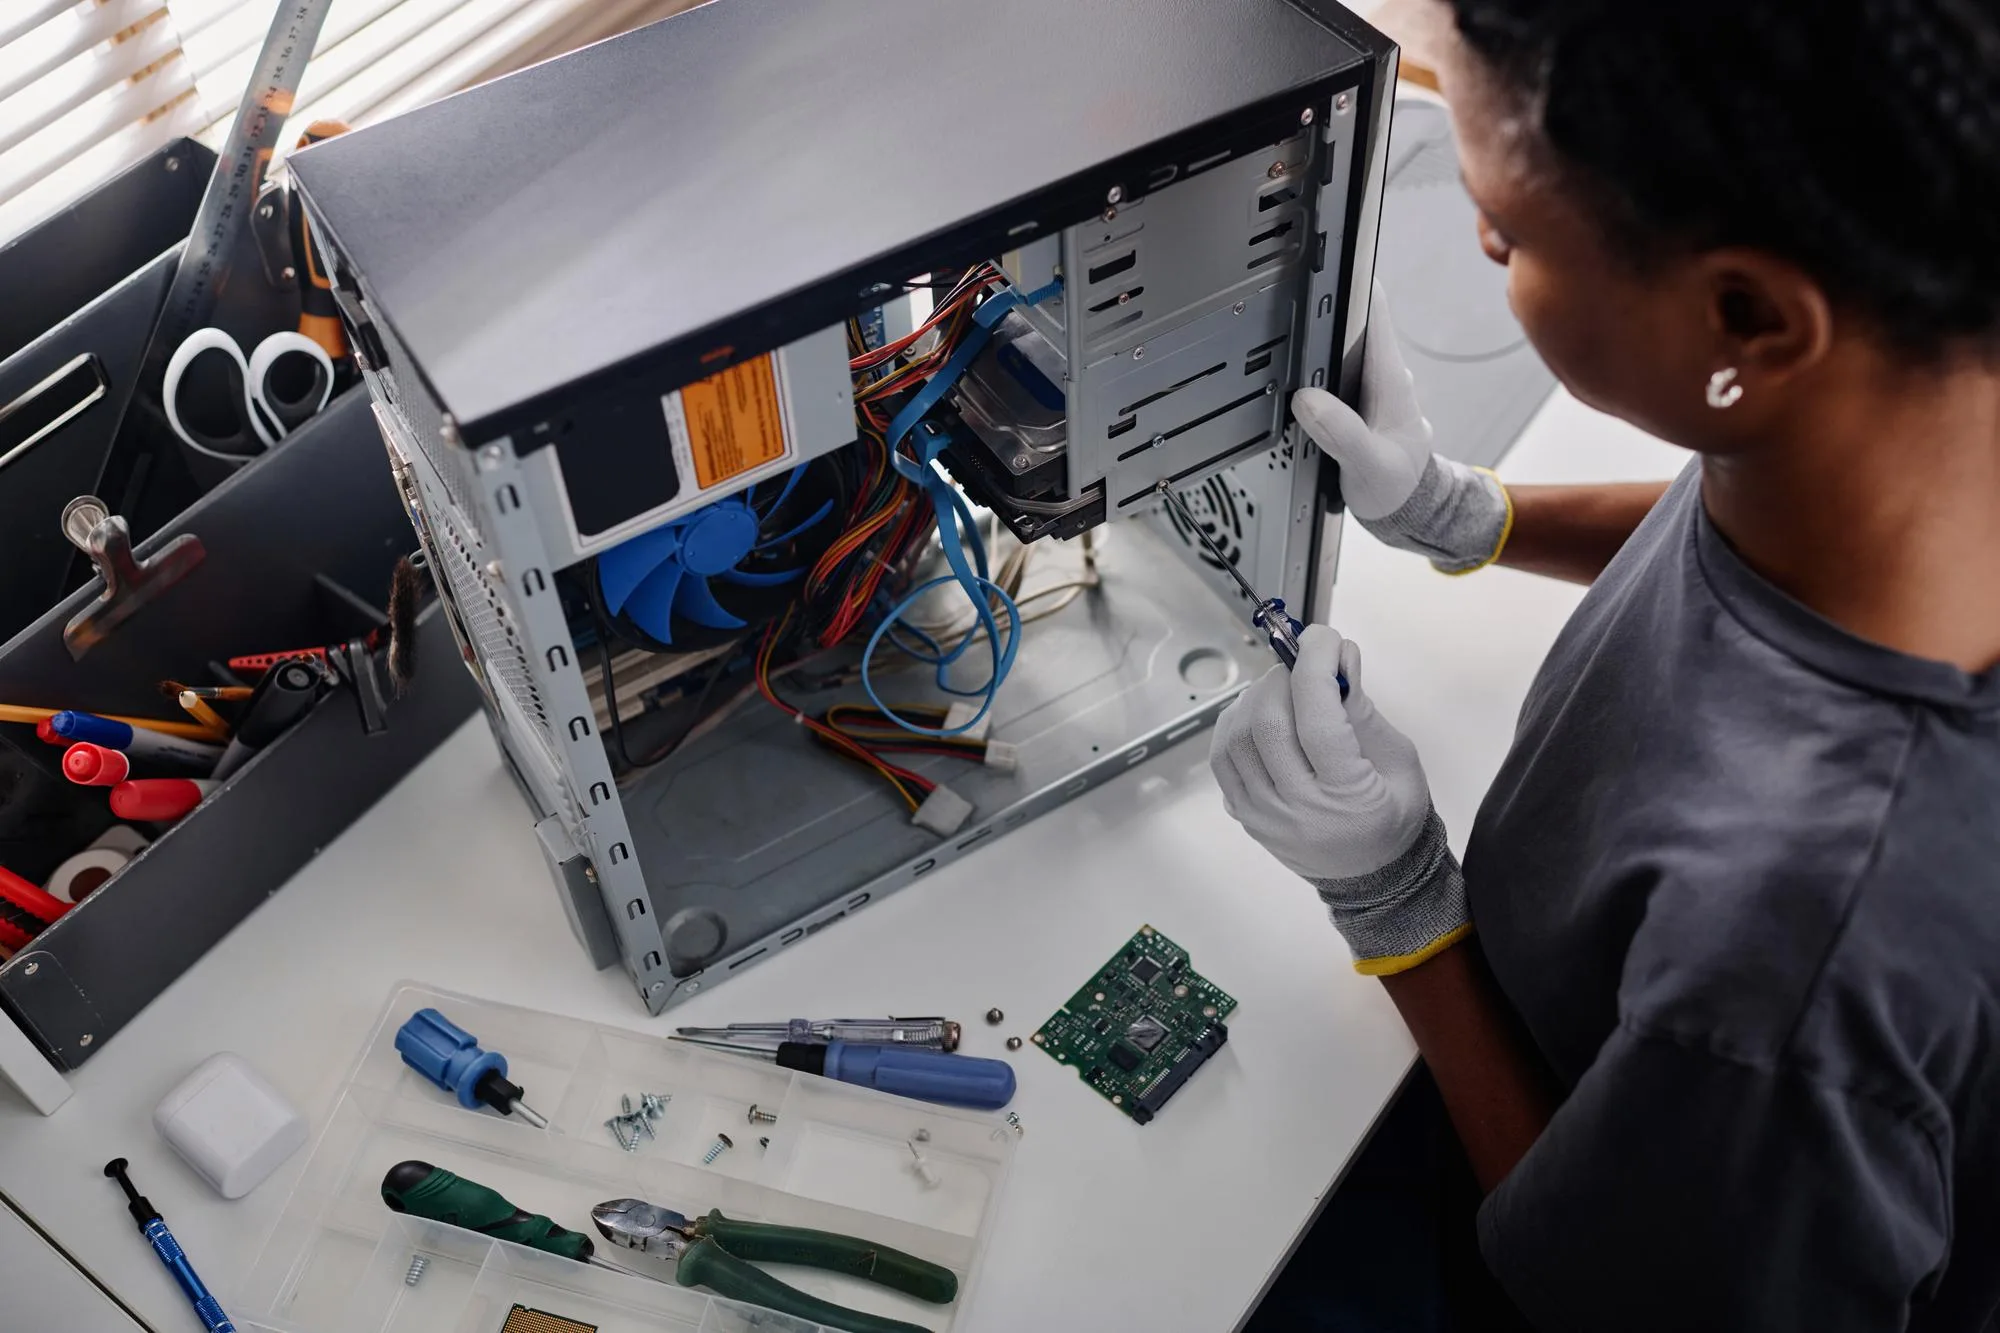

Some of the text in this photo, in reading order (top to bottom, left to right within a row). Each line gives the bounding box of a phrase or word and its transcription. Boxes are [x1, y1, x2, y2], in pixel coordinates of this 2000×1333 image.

[214, 222, 226, 239] 27
[235, 164, 248, 182] 30
[281, 46, 293, 62] 36
[288, 26, 300, 42] 37
